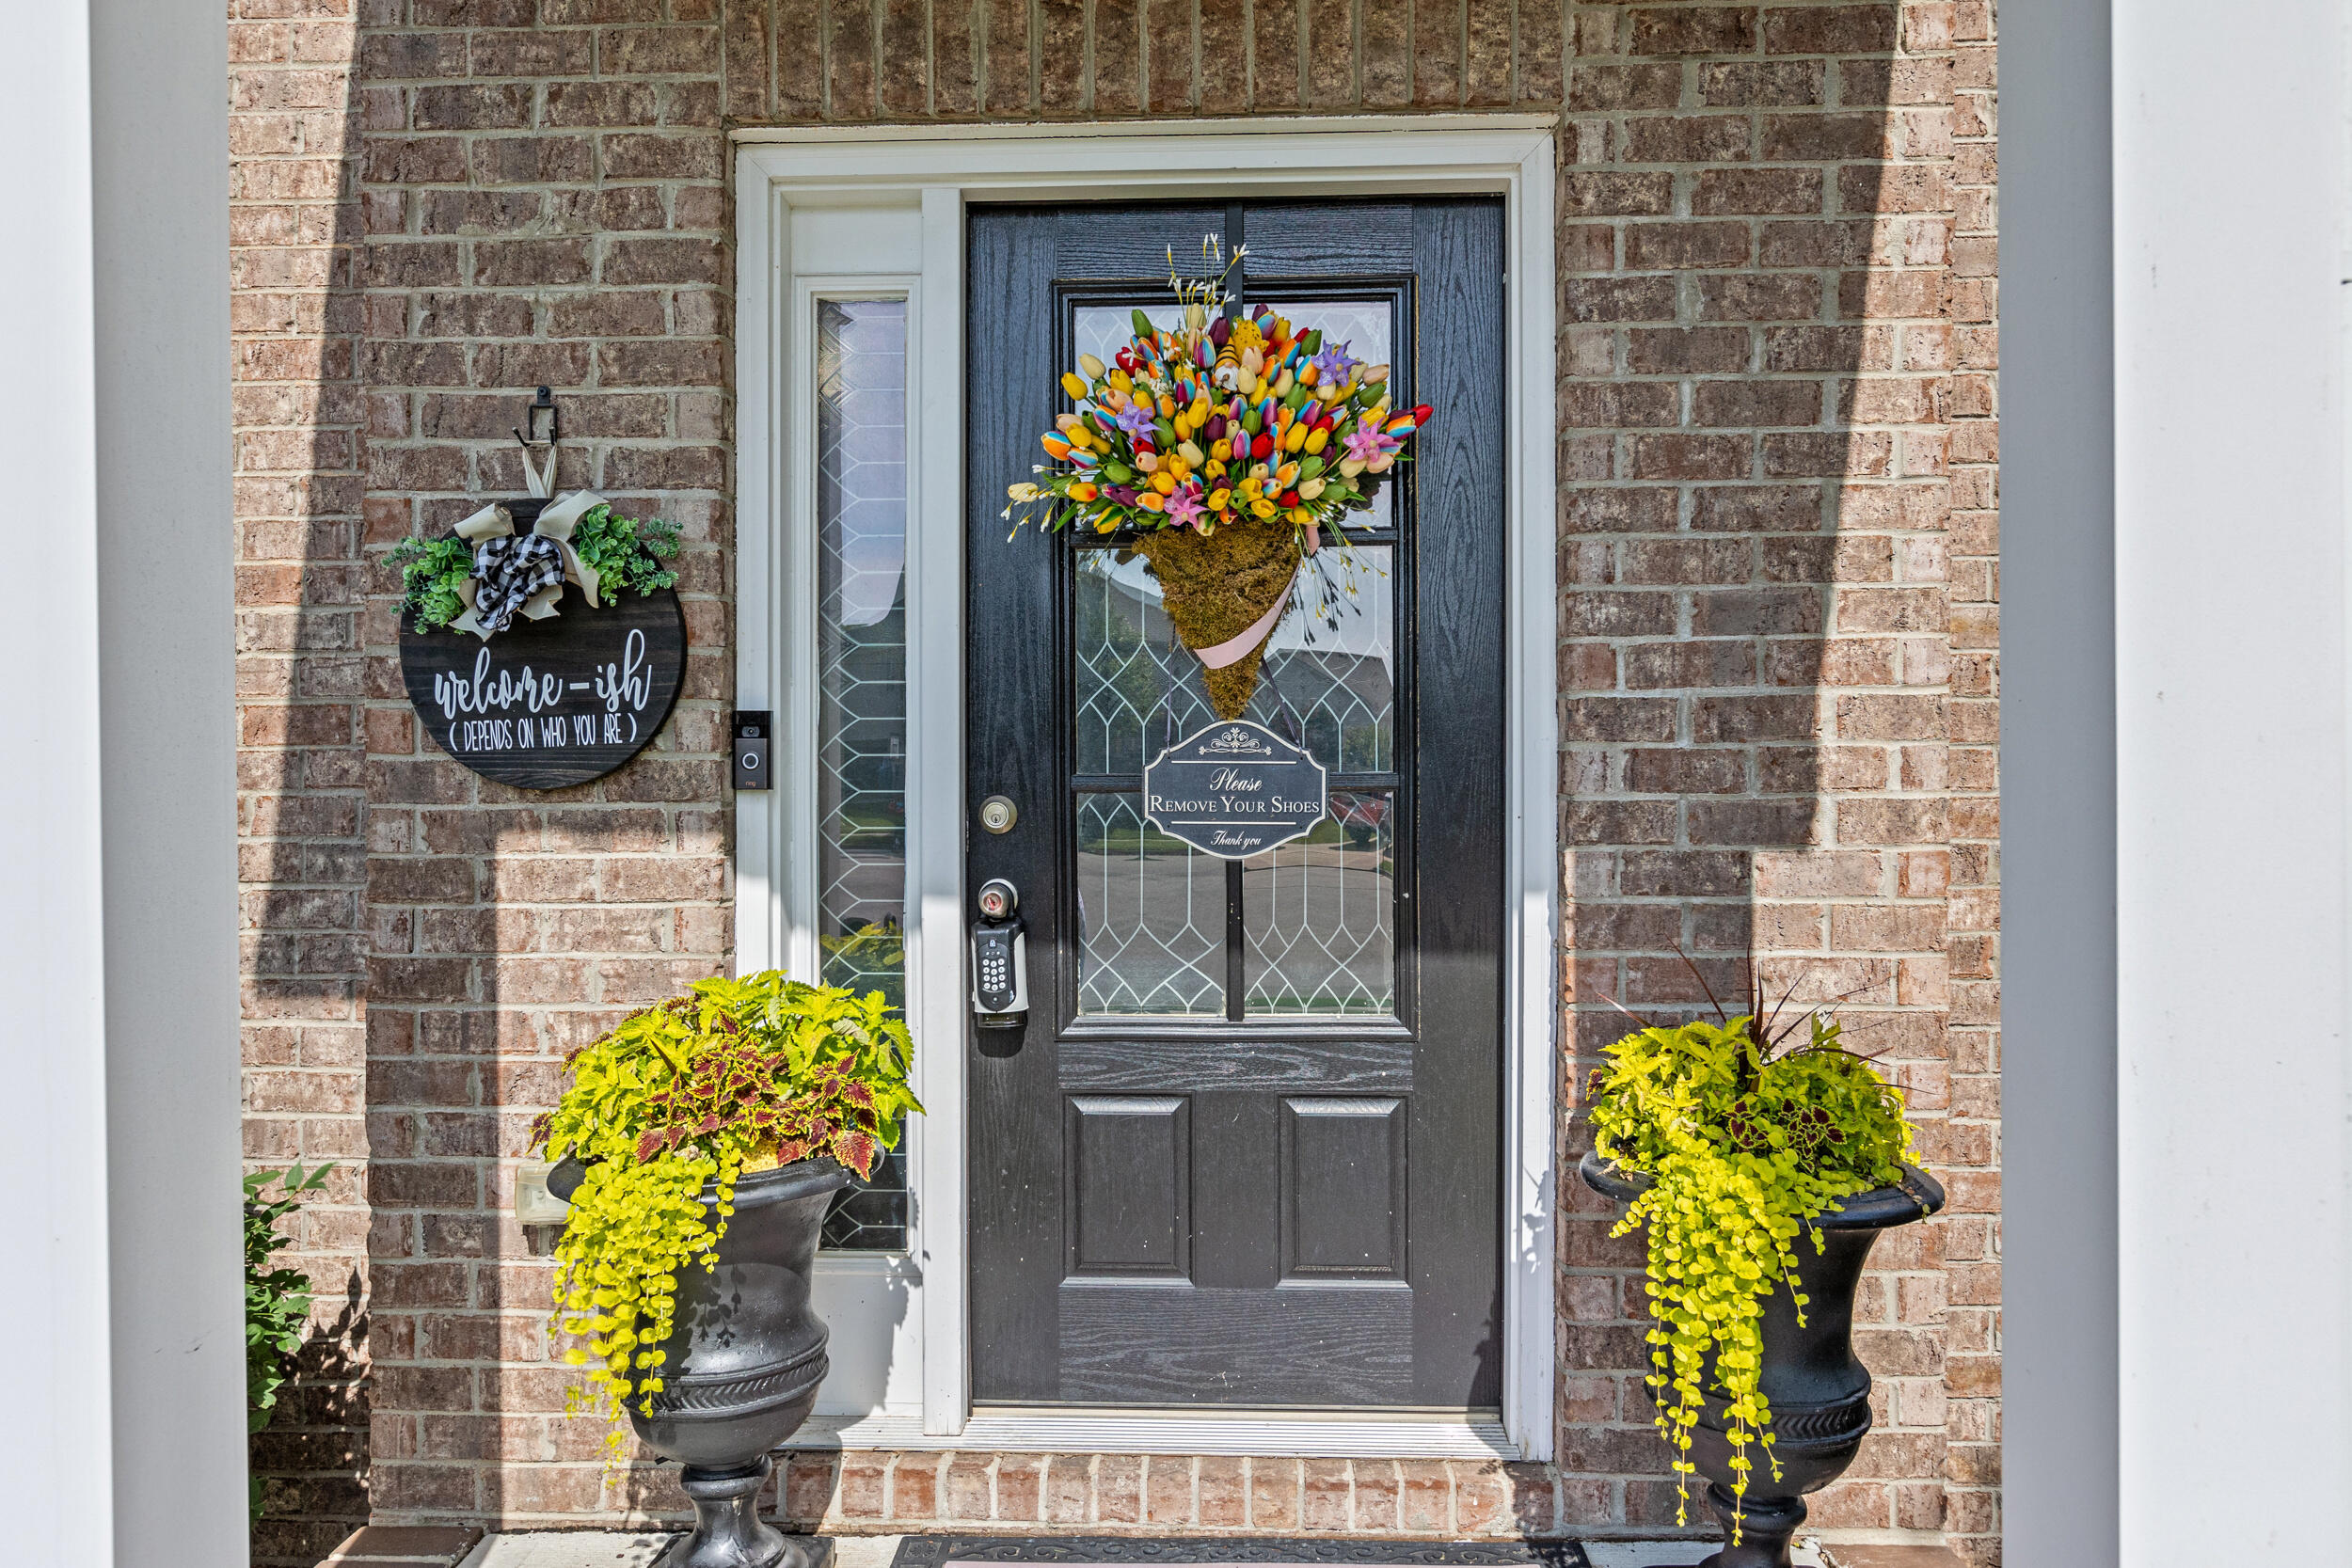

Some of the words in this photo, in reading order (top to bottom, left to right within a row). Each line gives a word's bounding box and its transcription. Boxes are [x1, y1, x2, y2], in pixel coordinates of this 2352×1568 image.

[464, 719, 513, 751] DEPENDS
[517, 718, 534, 749] ON
[540, 717, 566, 748] WHO
[573, 714, 596, 746] YOU
[604, 712, 623, 744] ARE
[1209, 767, 1263, 791] Please
[1149, 795, 1217, 813] REMOVE
[1220, 796, 1266, 813] YOUR
[1271, 796, 1320, 814] SHOES
[1210, 831, 1243, 846] Thank
[1242, 836, 1262, 850] you
